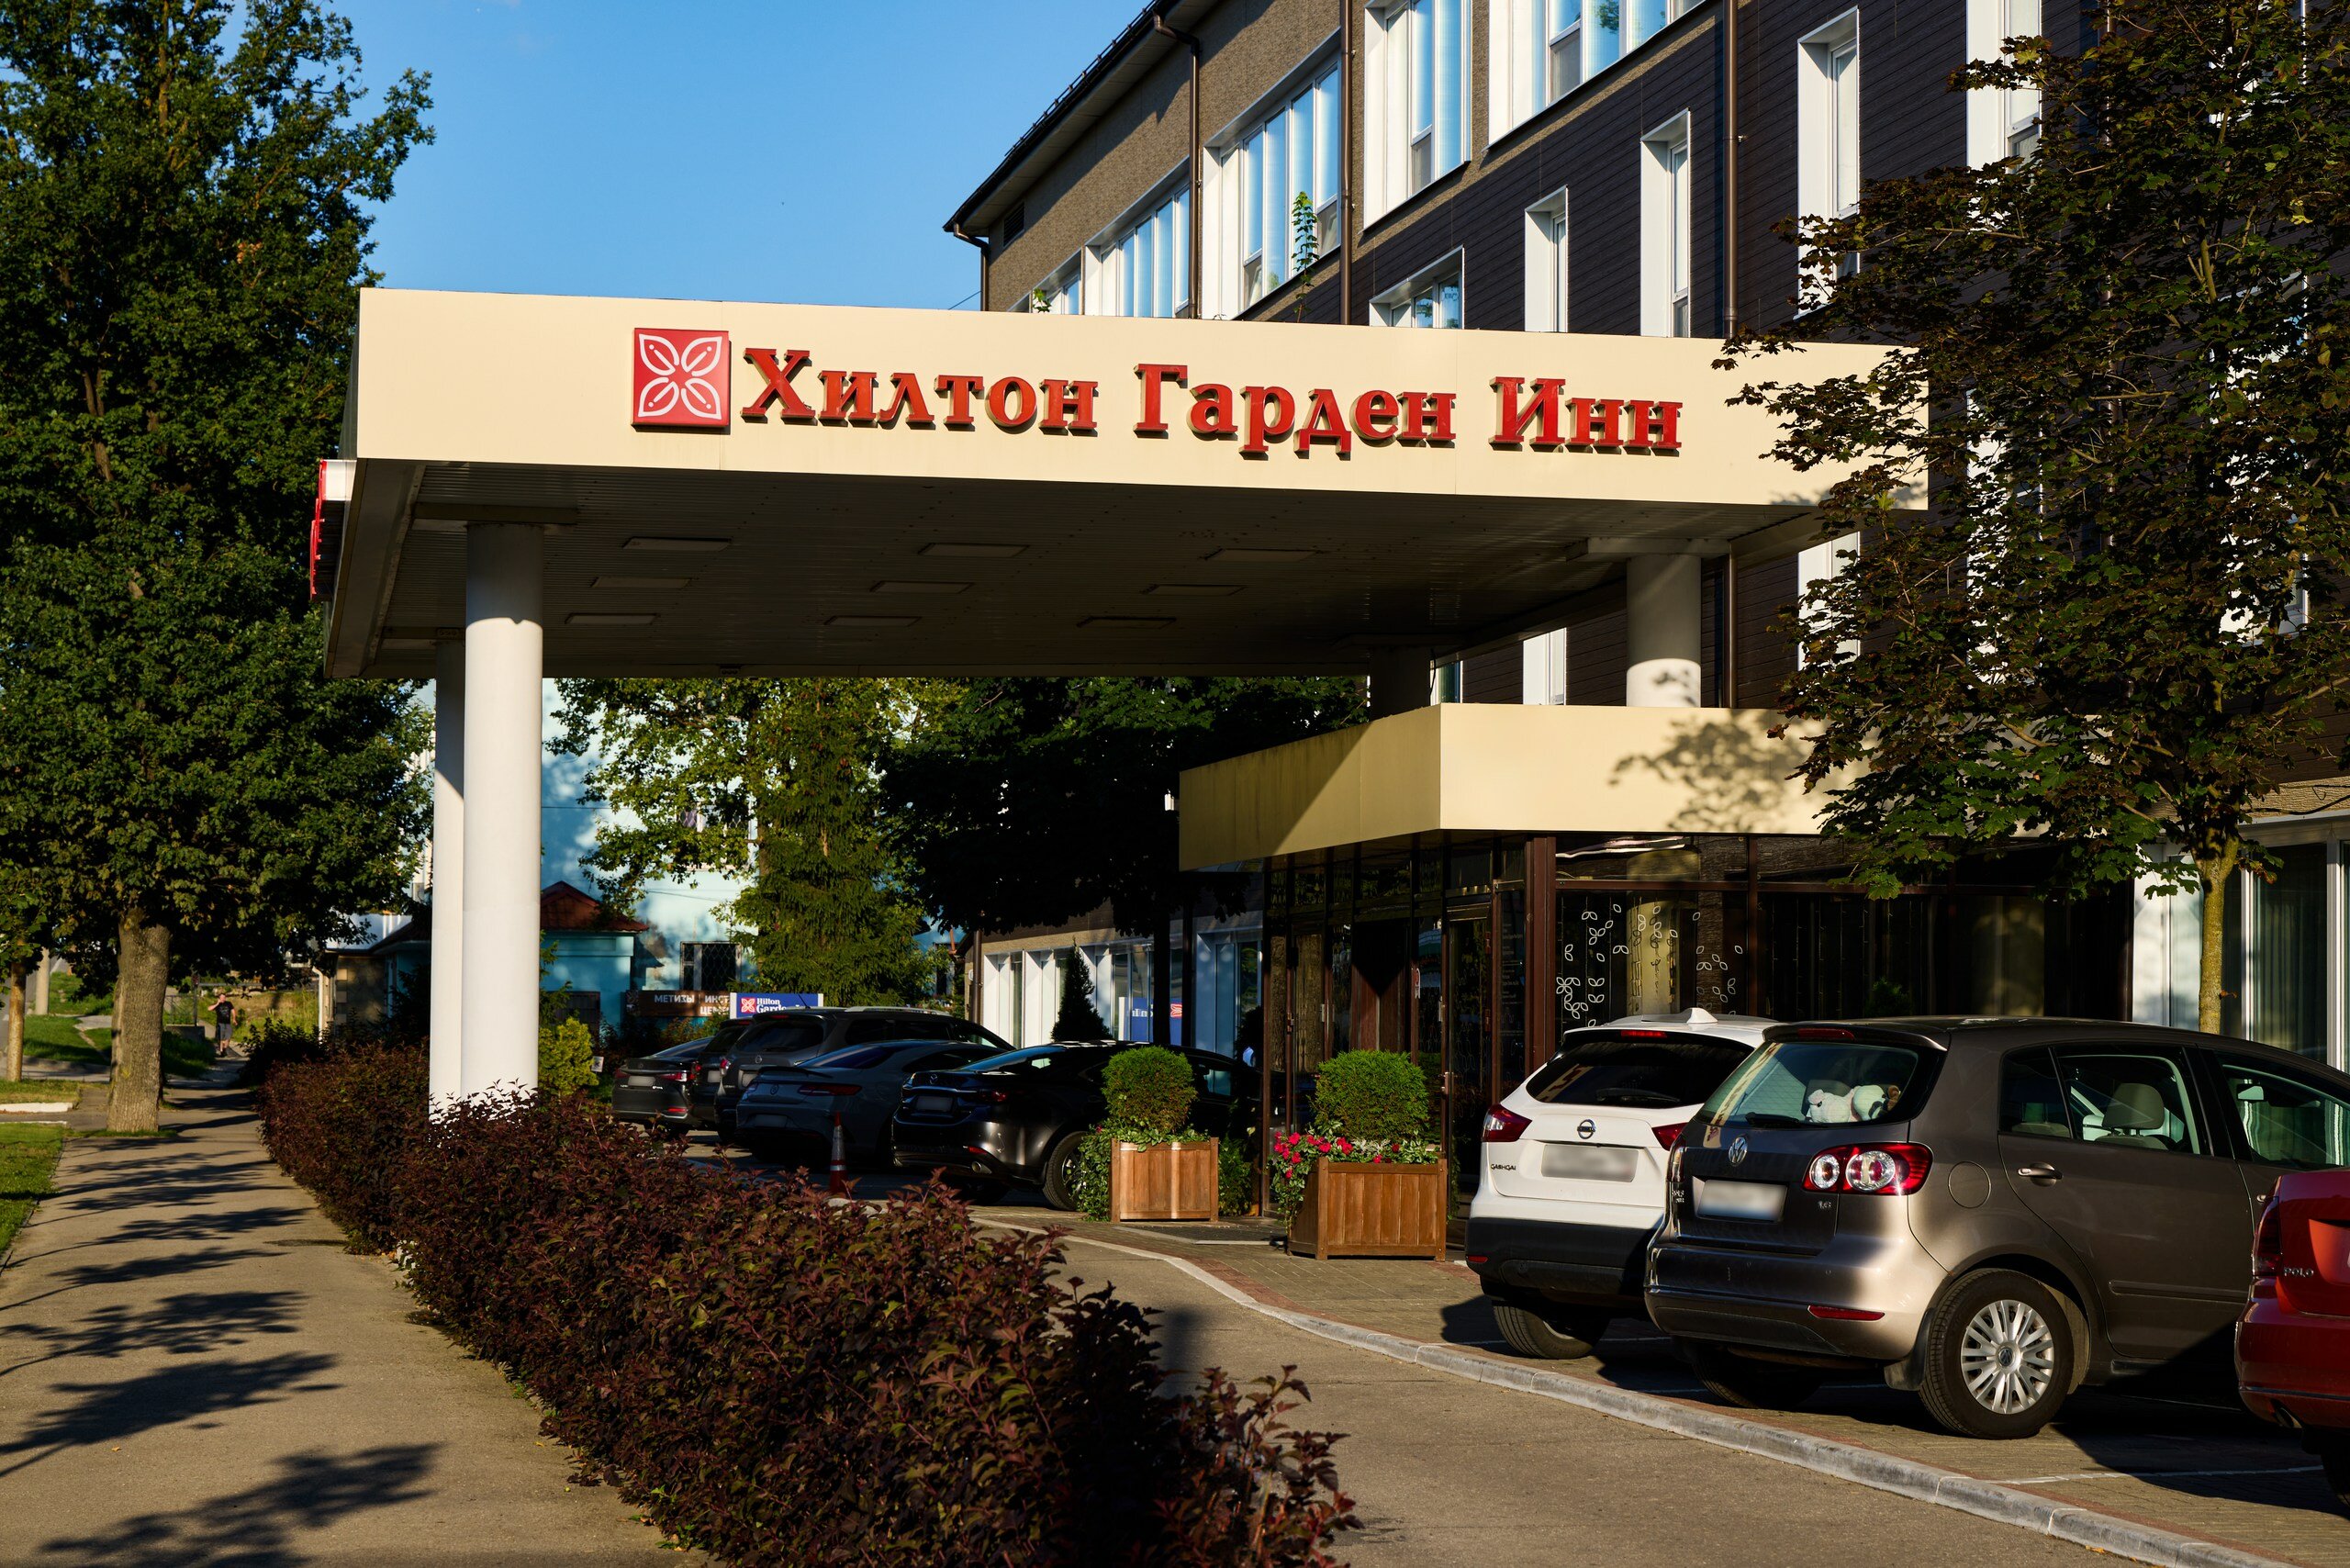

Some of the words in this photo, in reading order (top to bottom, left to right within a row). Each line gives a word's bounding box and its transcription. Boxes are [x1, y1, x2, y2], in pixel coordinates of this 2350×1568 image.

[741, 347, 1099, 435] Хилтон
[1134, 364, 1457, 459] Гарден
[1489, 376, 1683, 454] Инн
[655, 994, 695, 1003] МЕТИЗЫ
[704, 994, 730, 1003] ИНСТ
[756, 997, 780, 1005] Hilton
[755, 1004, 787, 1014] Garde
[2284, 1267, 2314, 1277] POLO
